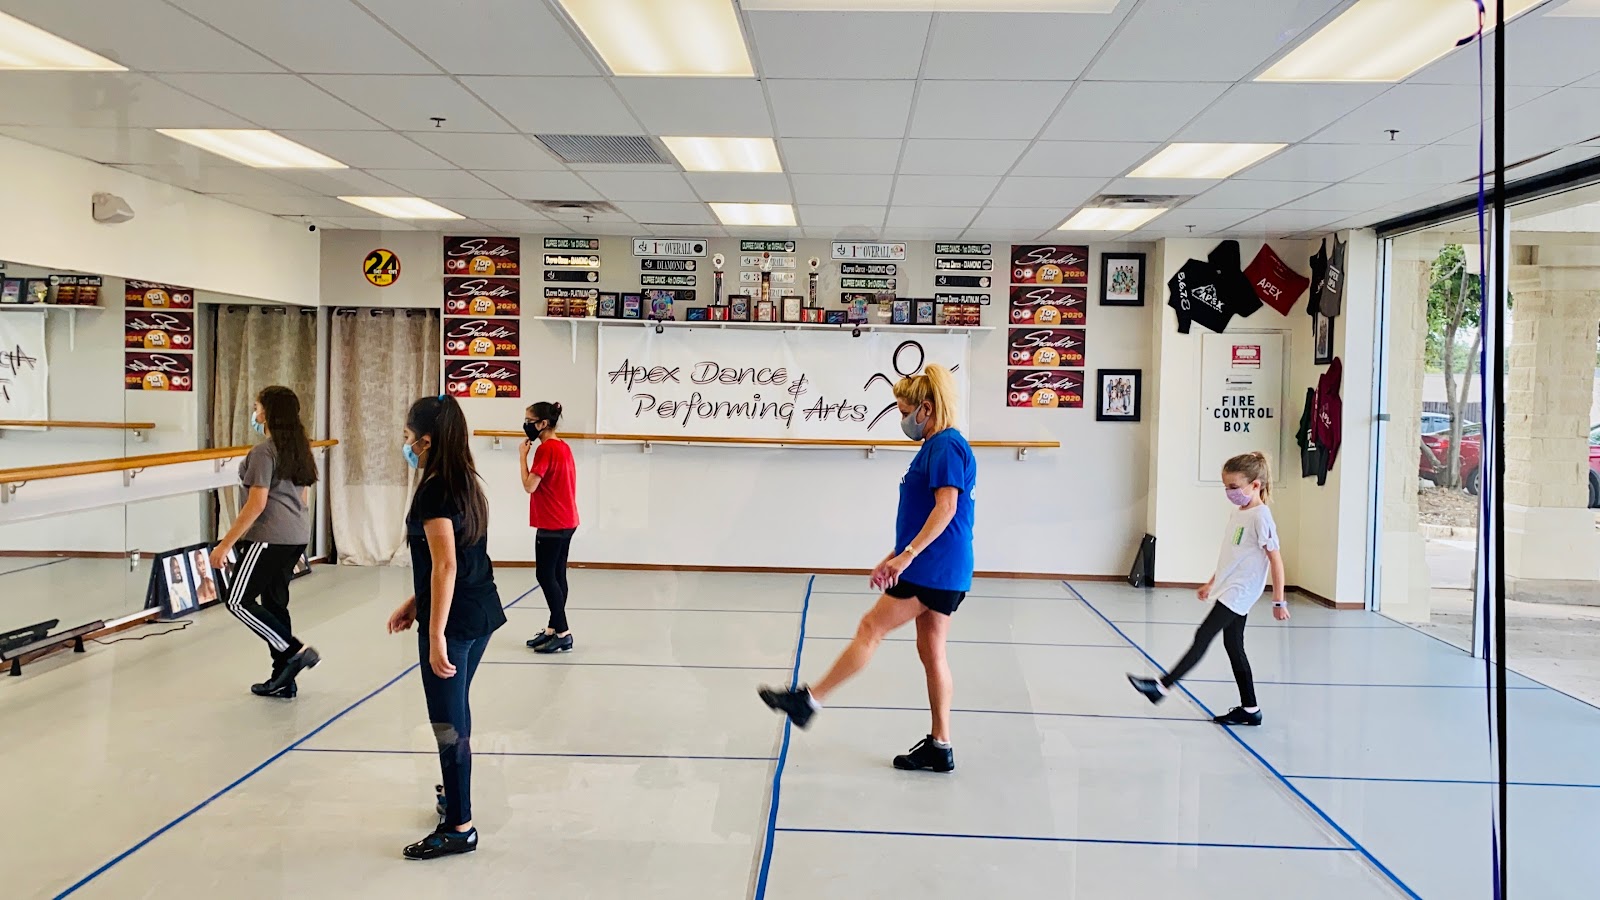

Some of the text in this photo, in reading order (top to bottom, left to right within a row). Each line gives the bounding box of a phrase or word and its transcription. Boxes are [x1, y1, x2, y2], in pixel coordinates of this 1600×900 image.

[664, 242, 693, 255] OVERALL
[863, 245, 891, 258] OVERALL
[949, 245, 961, 253] DANCE
[365, 250, 398, 283] 24
[475, 258, 492, 271] Top
[656, 260, 685, 271] DIAMOND
[842, 264, 854, 274] Dupree
[855, 264, 866, 273] Dance
[867, 265, 886, 274] DIAMOND
[950, 260, 961, 269] Dance
[963, 260, 982, 269] DIAMOND
[655, 275, 666, 284] DANCE
[1042, 267, 1059, 280] Top
[1256, 277, 1283, 301] APEX
[475, 299, 492, 312] Top
[949, 294, 960, 304] Dance
[960, 295, 980, 304] PLATINUM
[1199, 291, 1225, 310] APEX
[496, 302, 518, 310] 2020
[1041, 308, 1057, 321] Top
[474, 340, 491, 353] Top
[1039, 350, 1056, 363] Top
[608, 358, 810, 401] Apex Dance &
[475, 382, 493, 394] Top
[1037, 391, 1055, 404] Top
[1221, 395, 1255, 407] FIRE
[631, 391, 869, 430] Performing Arts
[1213, 407, 1274, 419] CONTROL
[1223, 421, 1250, 433] BOX
